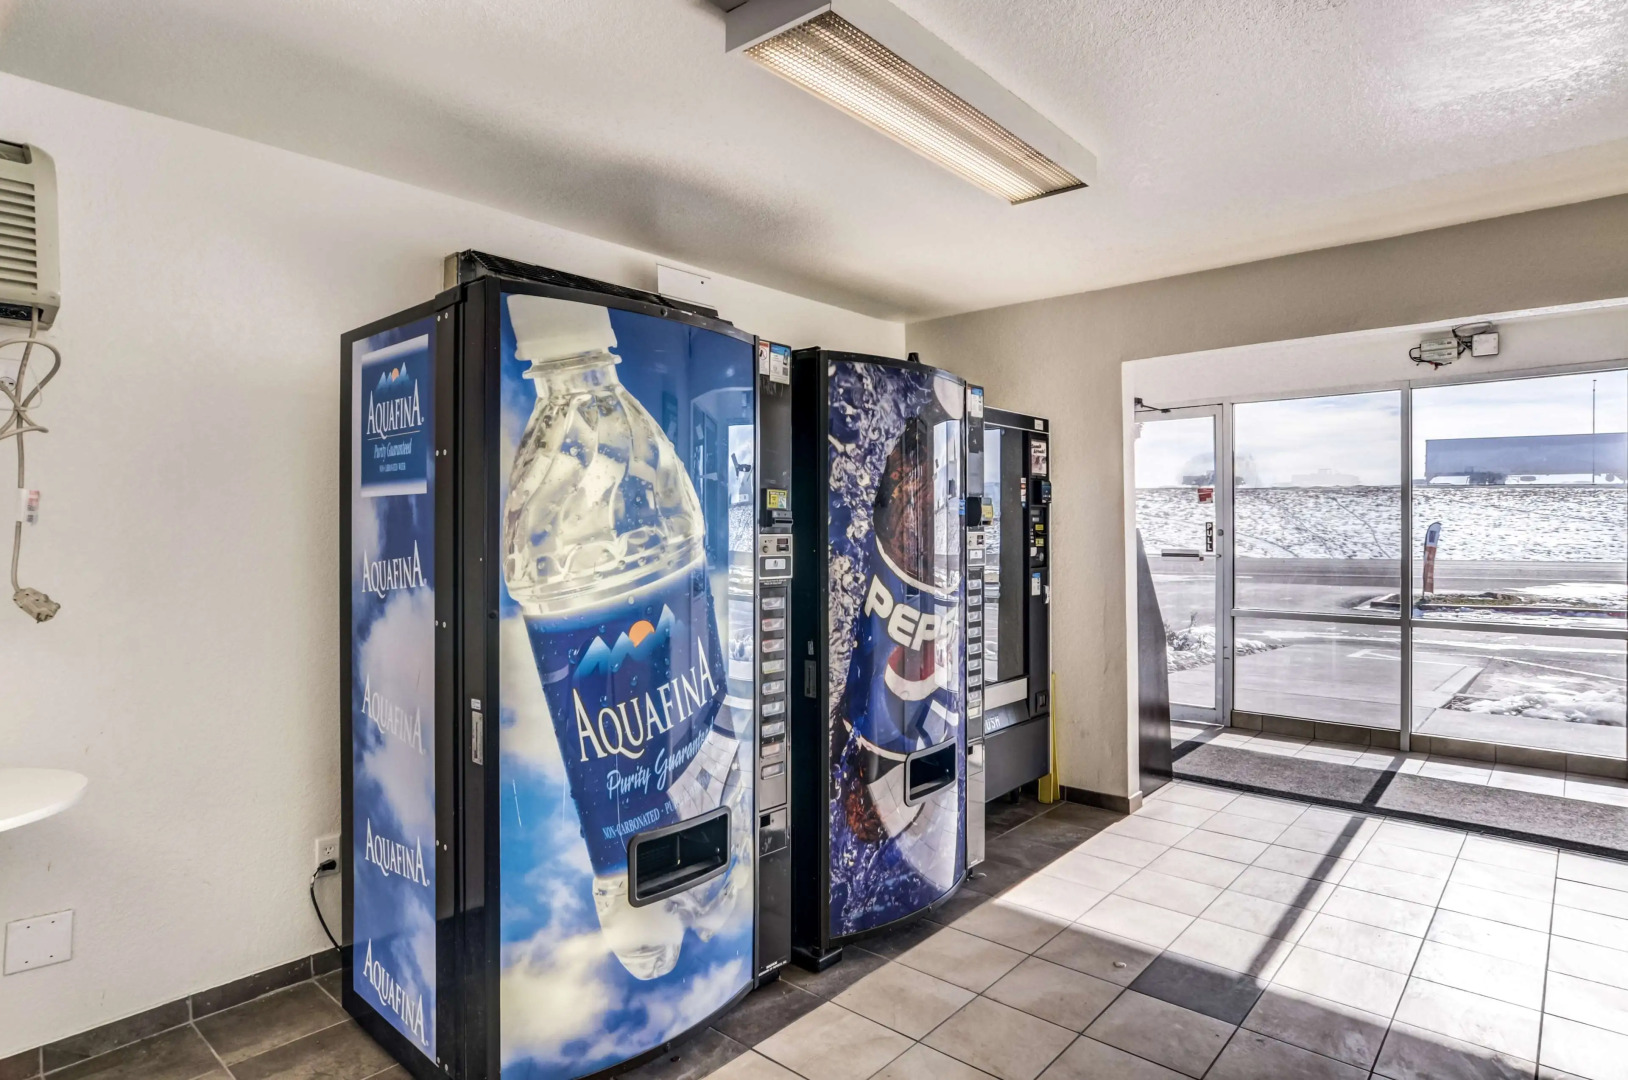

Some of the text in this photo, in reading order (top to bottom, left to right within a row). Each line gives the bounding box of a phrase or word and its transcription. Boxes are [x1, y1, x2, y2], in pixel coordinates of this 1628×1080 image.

[366, 378, 422, 440] AQUAFINA
[362, 540, 424, 599] AQUAFINA
[361, 672, 424, 755] AQUAFINA
[573, 636, 717, 763] AQUAFINA
[607, 766, 652, 800] Purity
[365, 818, 427, 888] AQUAFINA
[602, 808, 661, 840] NON-CARBONATED
[363, 938, 426, 1046] AQUAFINA
